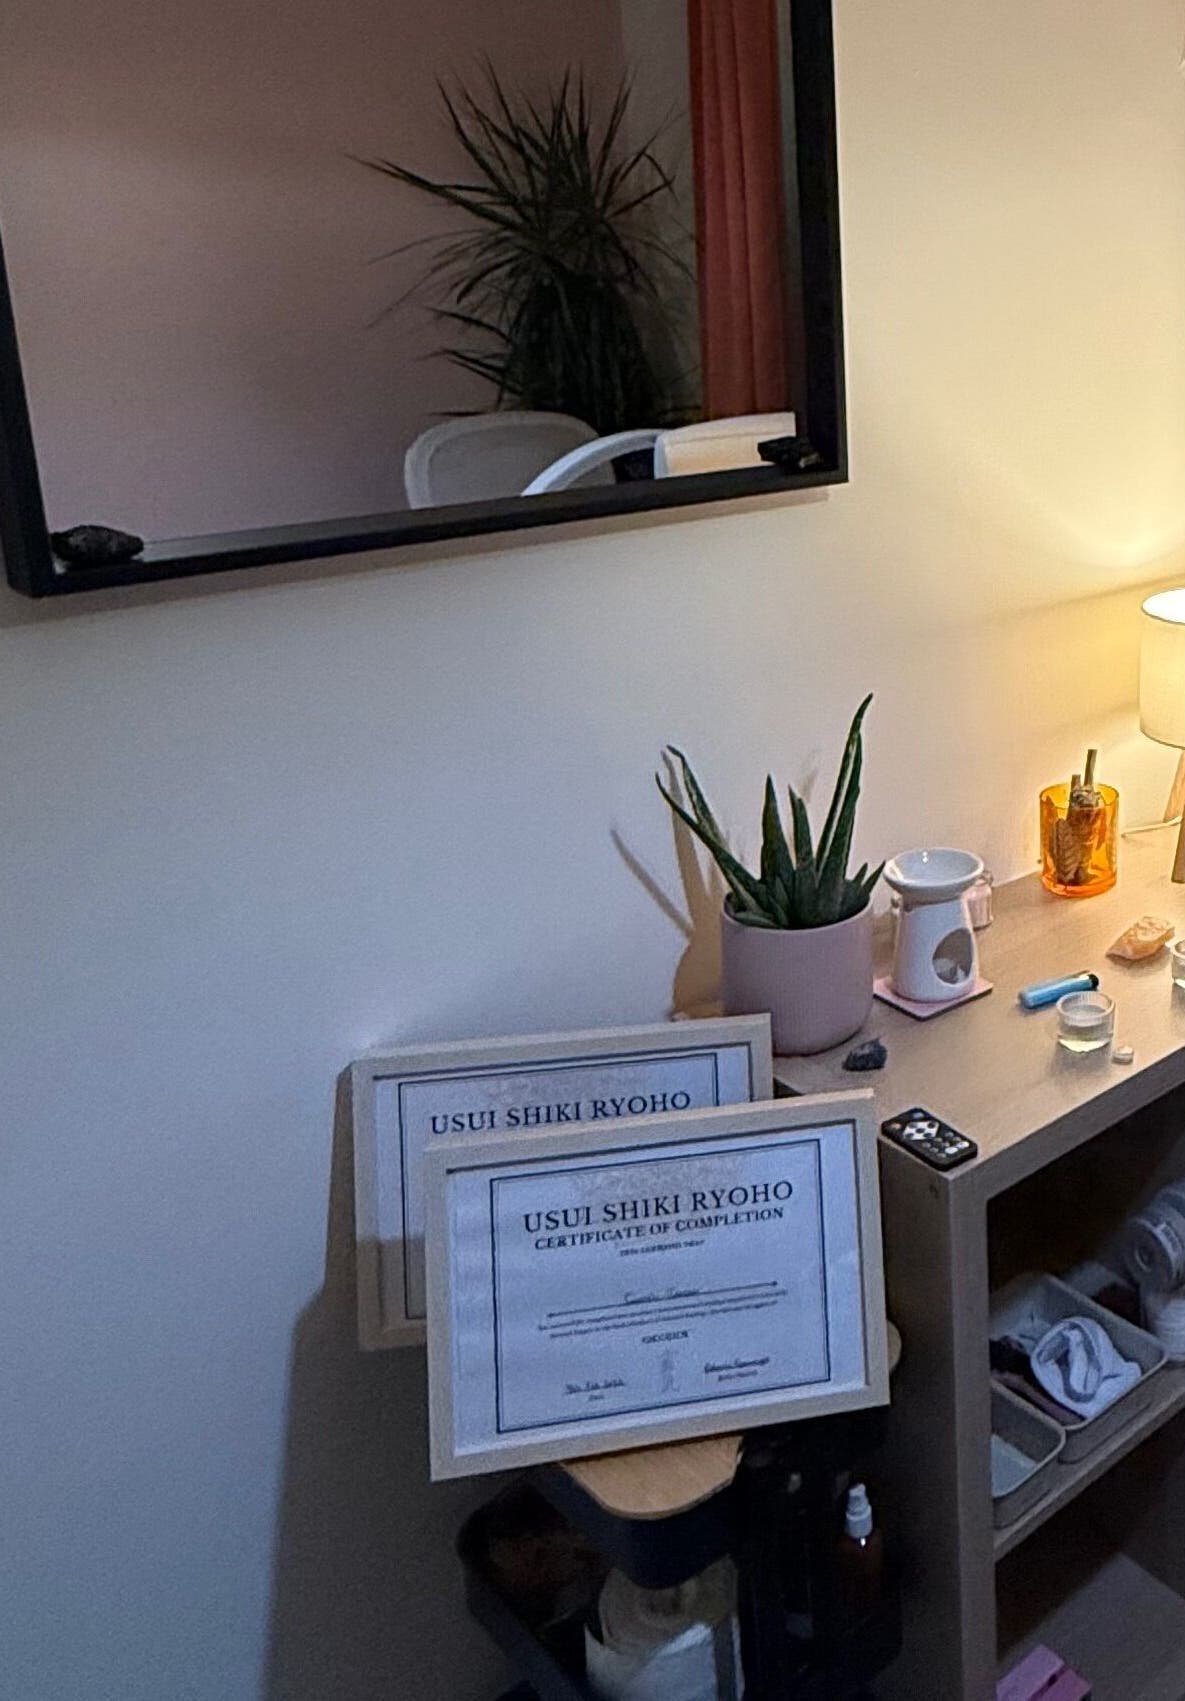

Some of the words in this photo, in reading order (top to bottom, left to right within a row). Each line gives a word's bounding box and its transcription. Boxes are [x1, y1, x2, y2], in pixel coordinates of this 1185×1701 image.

[431, 1112, 496, 1135] USUI
[506, 1102, 581, 1128] SHIKI
[592, 1091, 691, 1120] RYOHO
[523, 1207, 592, 1234] USUI
[602, 1194, 681, 1224] SHIKI
[692, 1180, 794, 1212] RYOHO
[534, 1225, 647, 1251] CERTIFICATE
[649, 1222, 672, 1237] OF
[675, 1206, 785, 1233] COMPLETION
